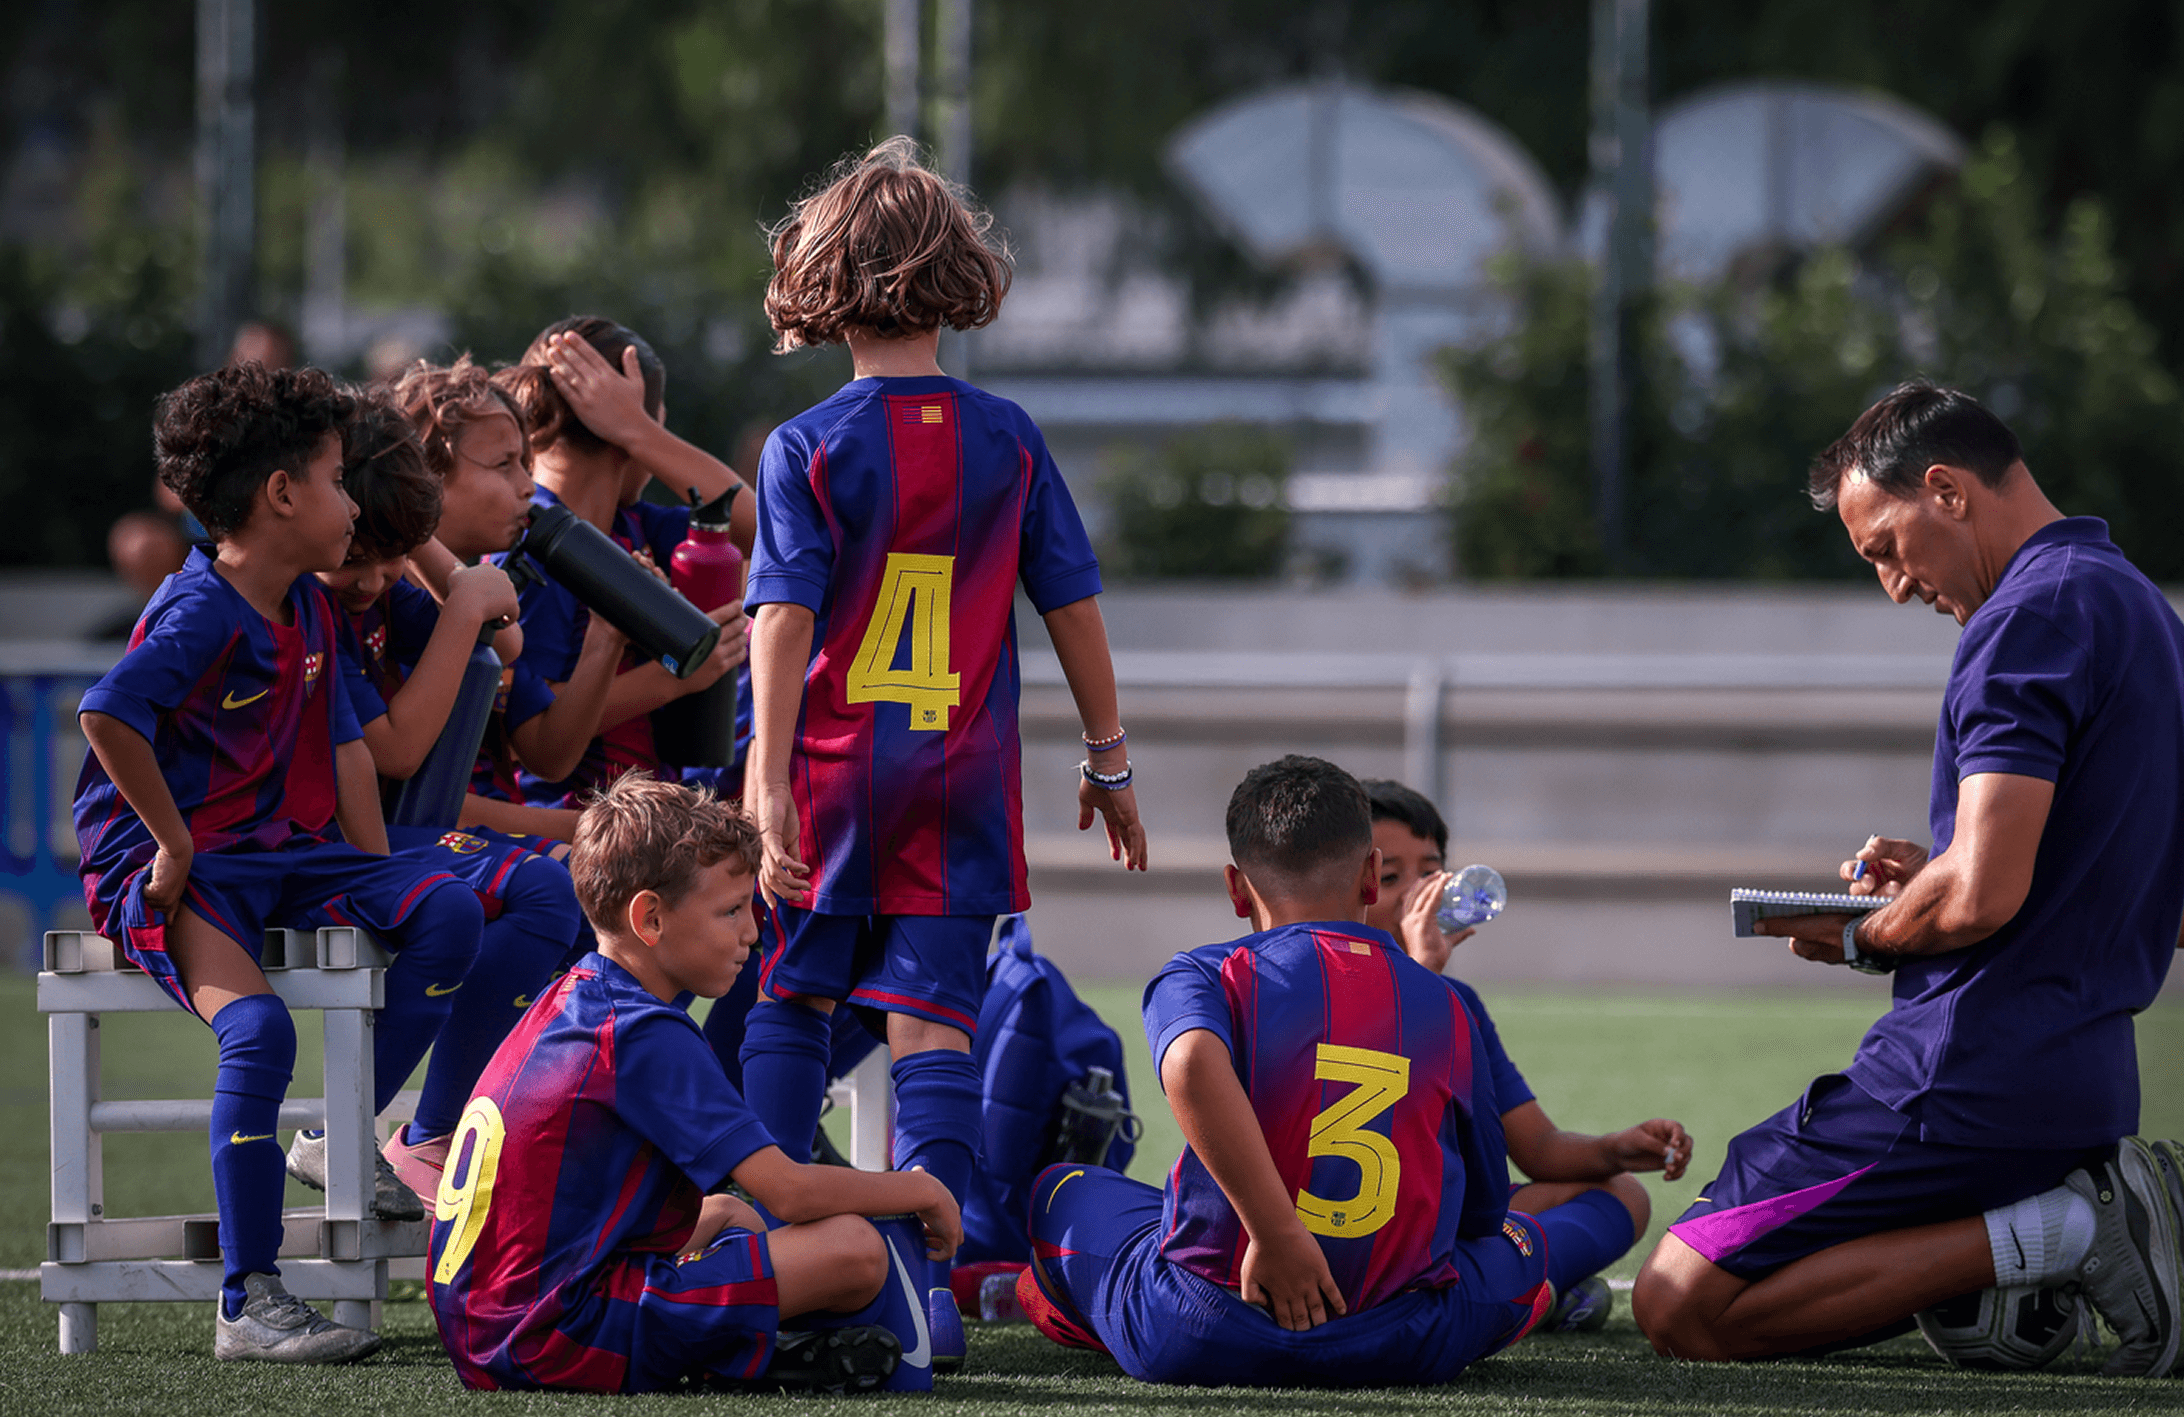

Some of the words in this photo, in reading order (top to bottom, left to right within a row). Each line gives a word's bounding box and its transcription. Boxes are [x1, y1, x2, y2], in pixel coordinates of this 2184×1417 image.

[847, 553, 961, 731] 4
[432, 1096, 506, 1285] 9
[1295, 1043, 1412, 1238] 3
